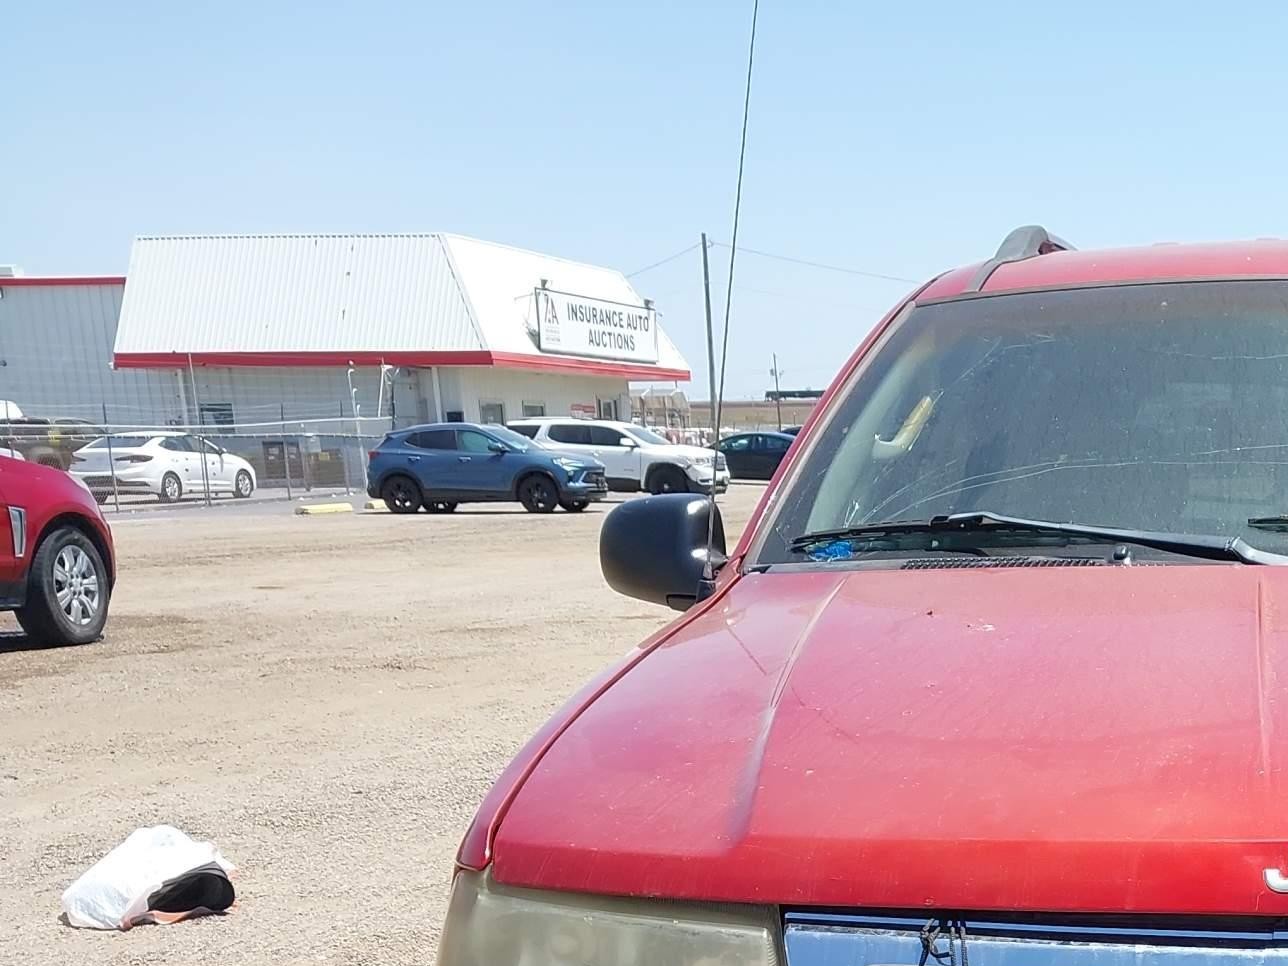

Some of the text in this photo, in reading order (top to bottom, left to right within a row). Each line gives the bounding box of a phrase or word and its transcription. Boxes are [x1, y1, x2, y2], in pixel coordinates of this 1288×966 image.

[567, 302, 650, 332] INSURANCE AUTO
[588, 329, 636, 351] AUCTIONS
